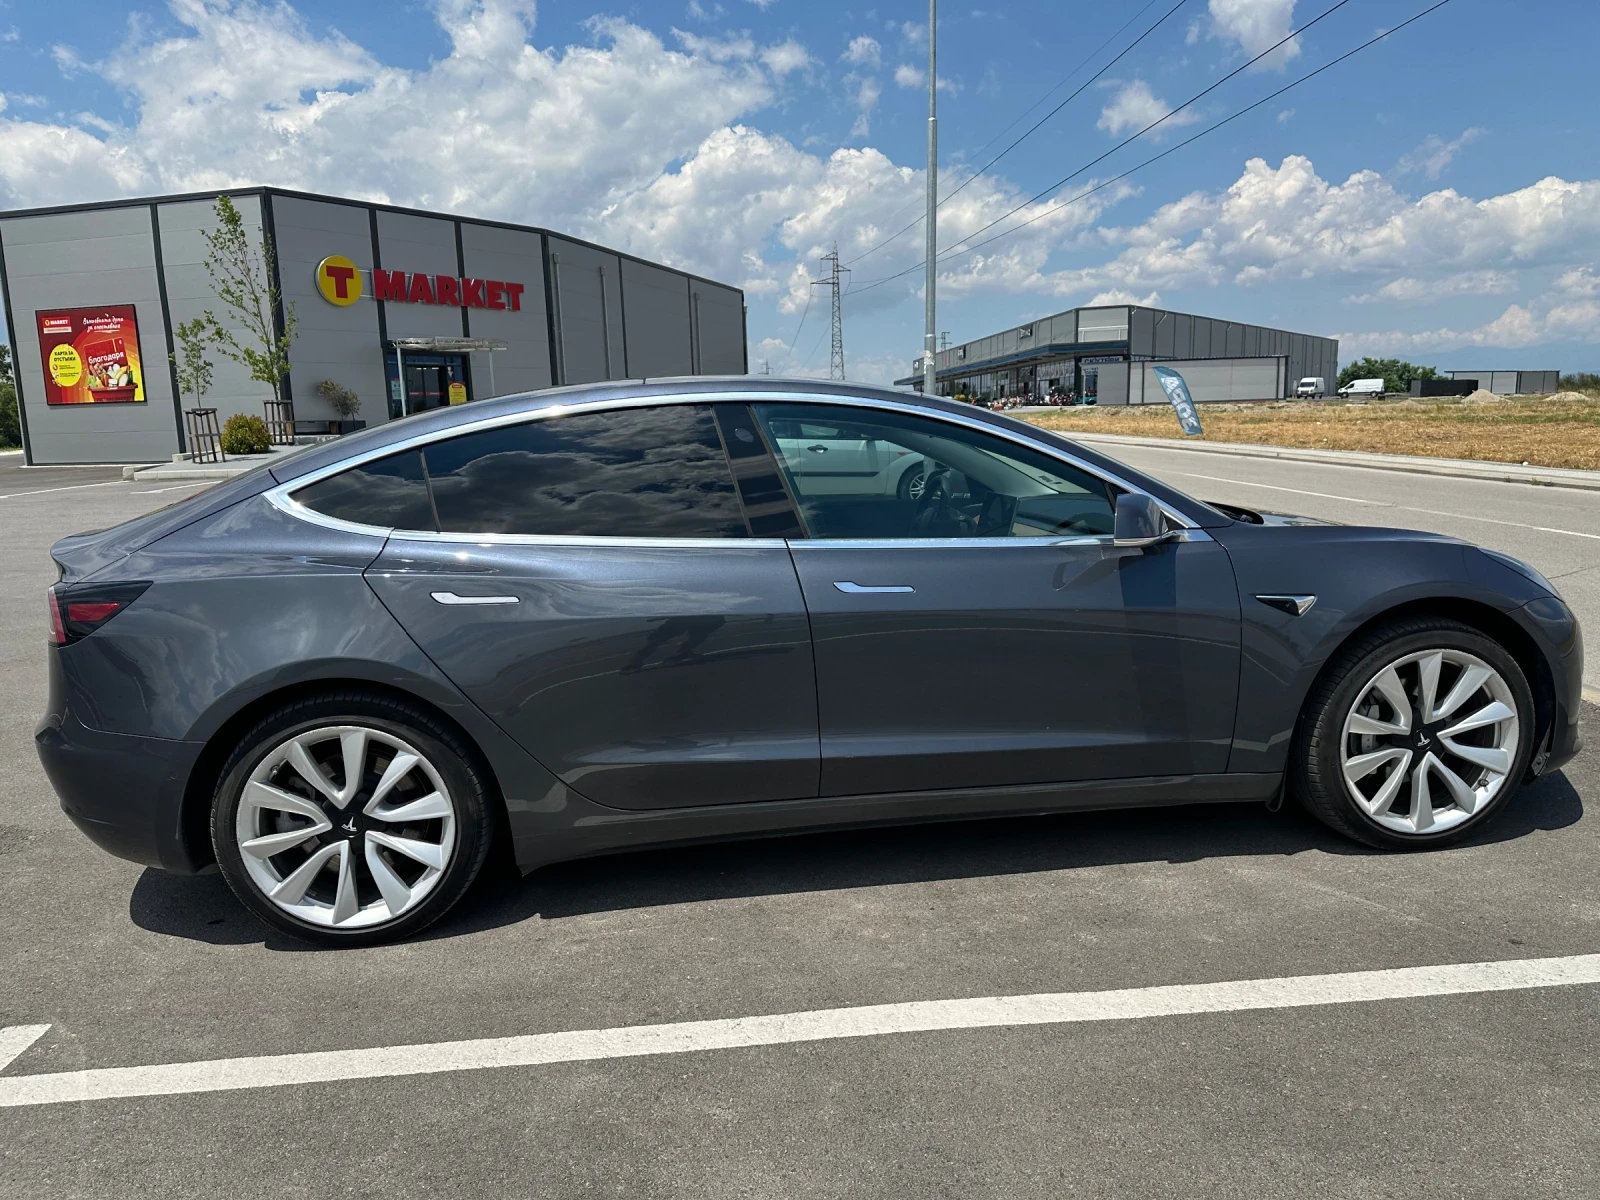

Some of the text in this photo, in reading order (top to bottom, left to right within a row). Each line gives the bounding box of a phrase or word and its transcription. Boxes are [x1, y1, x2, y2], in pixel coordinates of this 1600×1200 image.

[325, 265, 524, 311] T MARKET
[88, 351, 124, 364] благодаря
